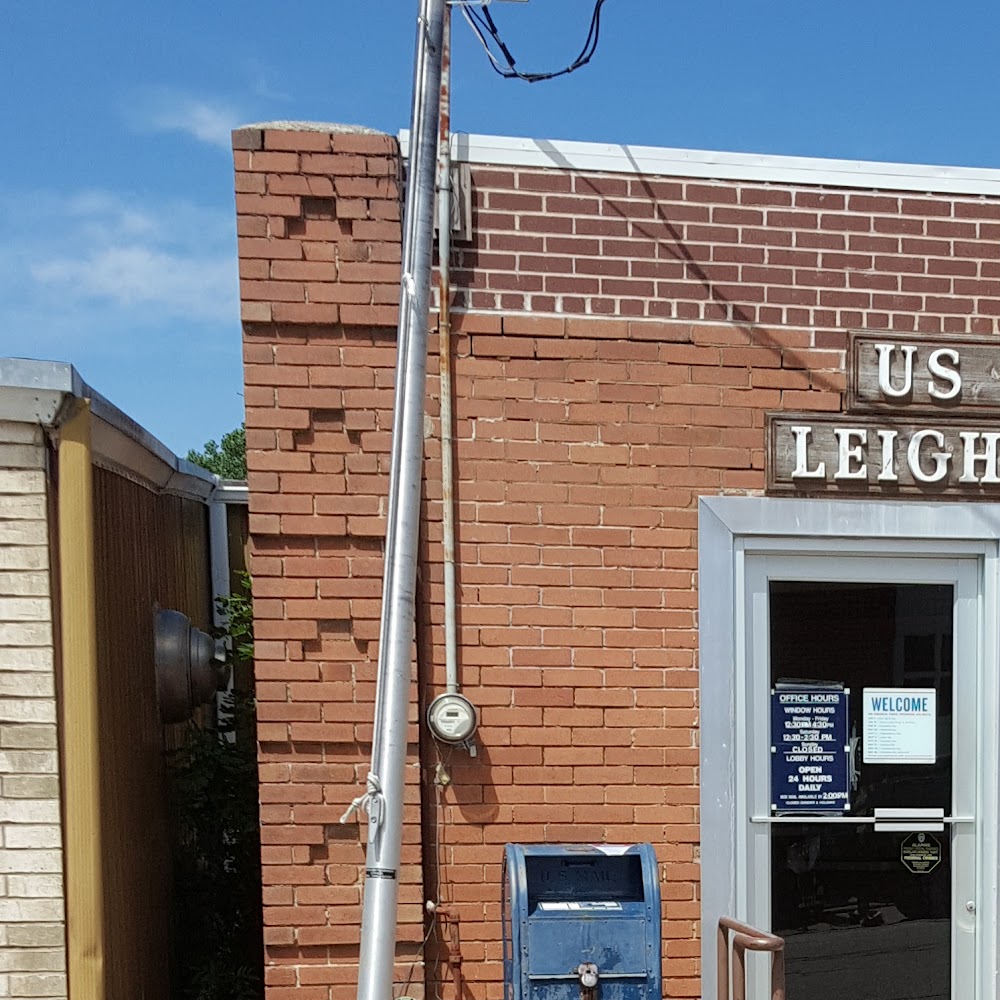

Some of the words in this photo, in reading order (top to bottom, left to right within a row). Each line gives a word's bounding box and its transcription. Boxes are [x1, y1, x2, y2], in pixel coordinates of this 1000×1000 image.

[875, 344, 962, 400] US
[779, 694, 808, 702] OFFICE
[810, 694, 839, 702] HOURS
[871, 697, 928, 712] WELCOME
